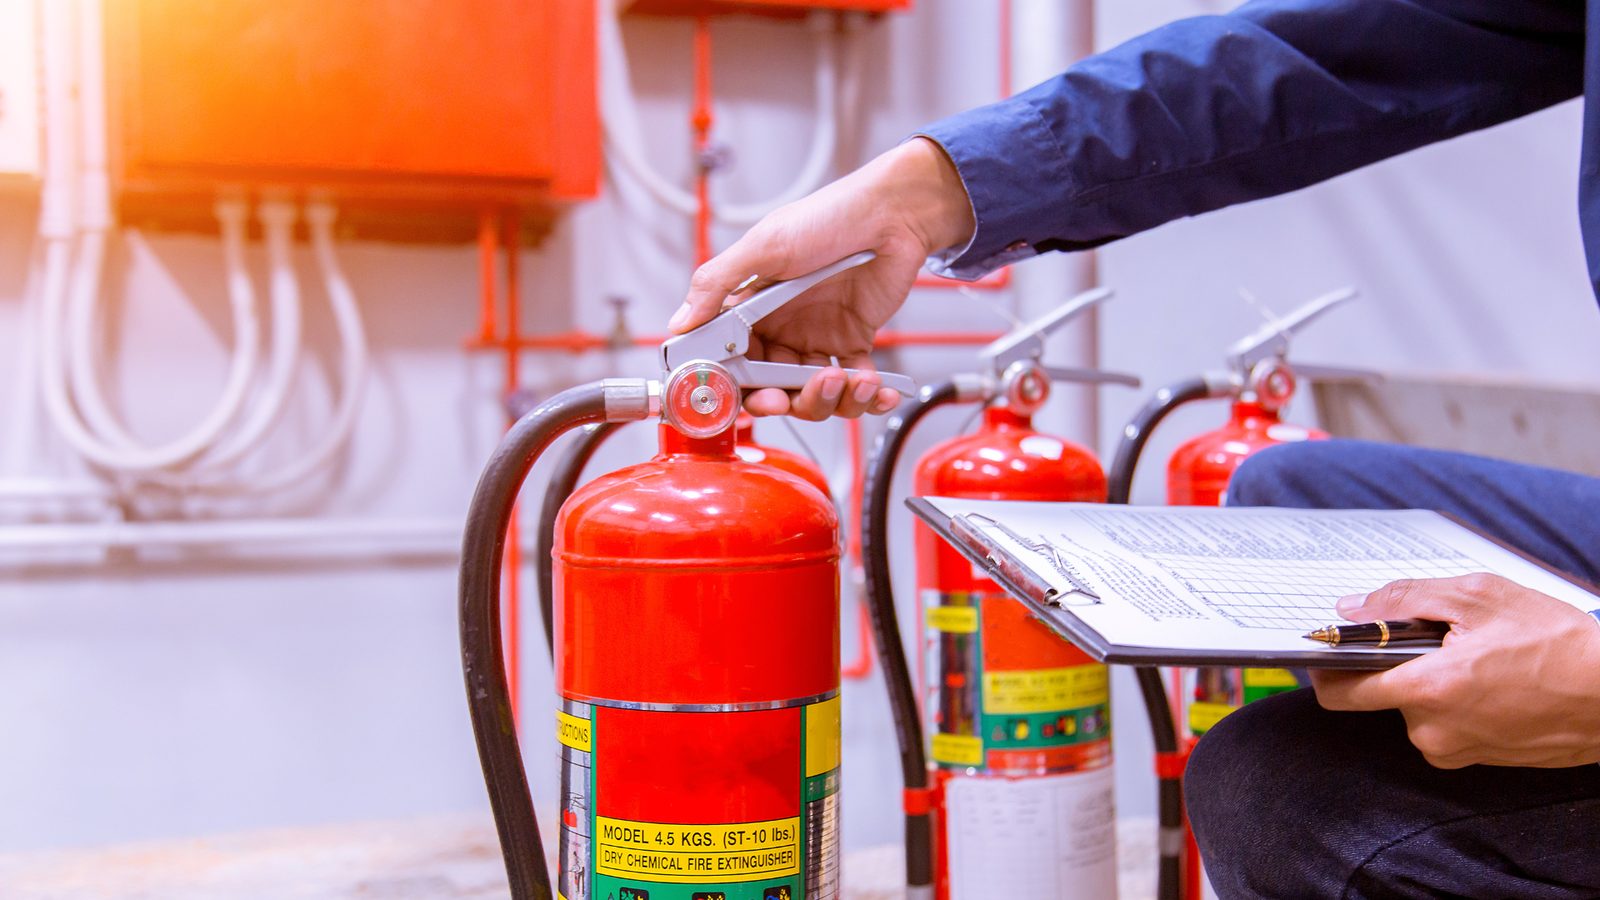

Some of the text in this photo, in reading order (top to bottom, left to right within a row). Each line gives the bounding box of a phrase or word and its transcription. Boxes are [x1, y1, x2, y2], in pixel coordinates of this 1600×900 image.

[604, 824, 649, 844] MODEL
[655, 832, 674, 845] 4.5
[681, 832, 716, 846] KGS.
[723, 830, 766, 848] (ST-10
[605, 850, 793, 870] DRY CHEMICAL FIRE EXTINGUISHER
